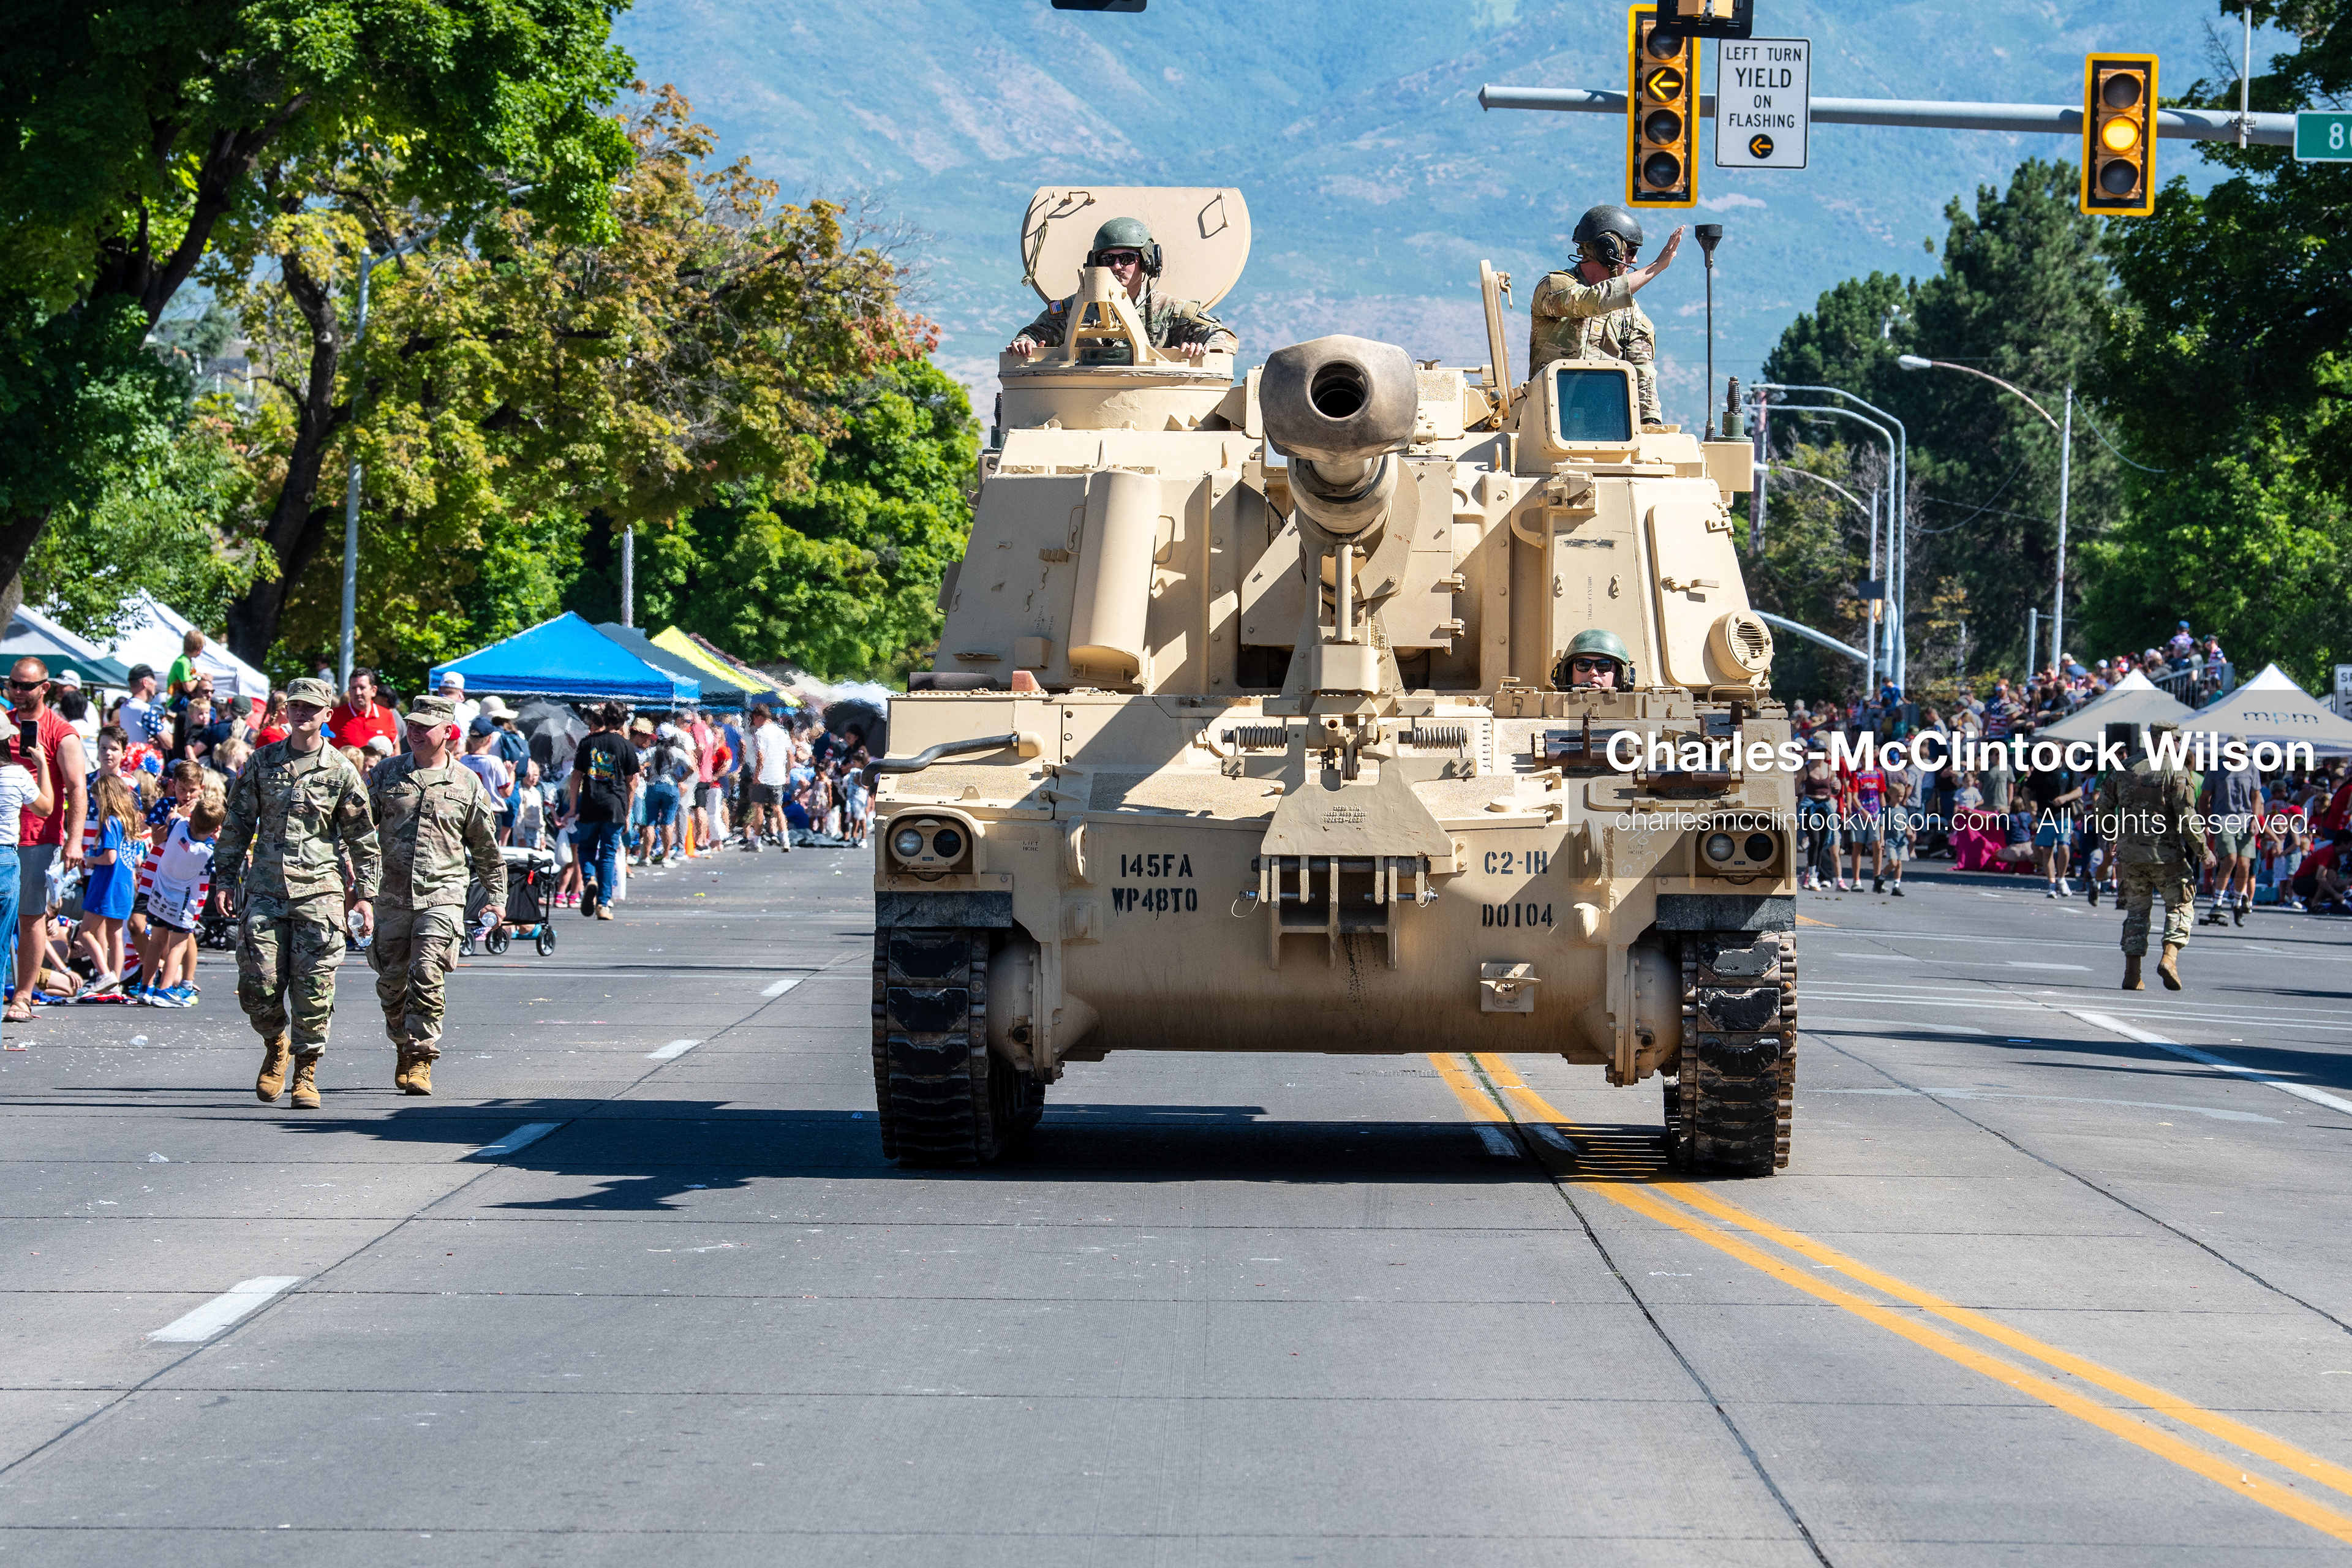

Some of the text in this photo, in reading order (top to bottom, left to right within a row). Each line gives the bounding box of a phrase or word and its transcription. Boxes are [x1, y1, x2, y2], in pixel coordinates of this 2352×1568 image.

[1726, 47, 1801, 61] LEFT TURN
[1735, 67, 1792, 88] YIELD
[1754, 94, 1771, 108] ON
[1728, 113, 1795, 128] FLASHING
[2329, 122, 2352, 151] 8
[2243, 712, 2319, 725] mpm
